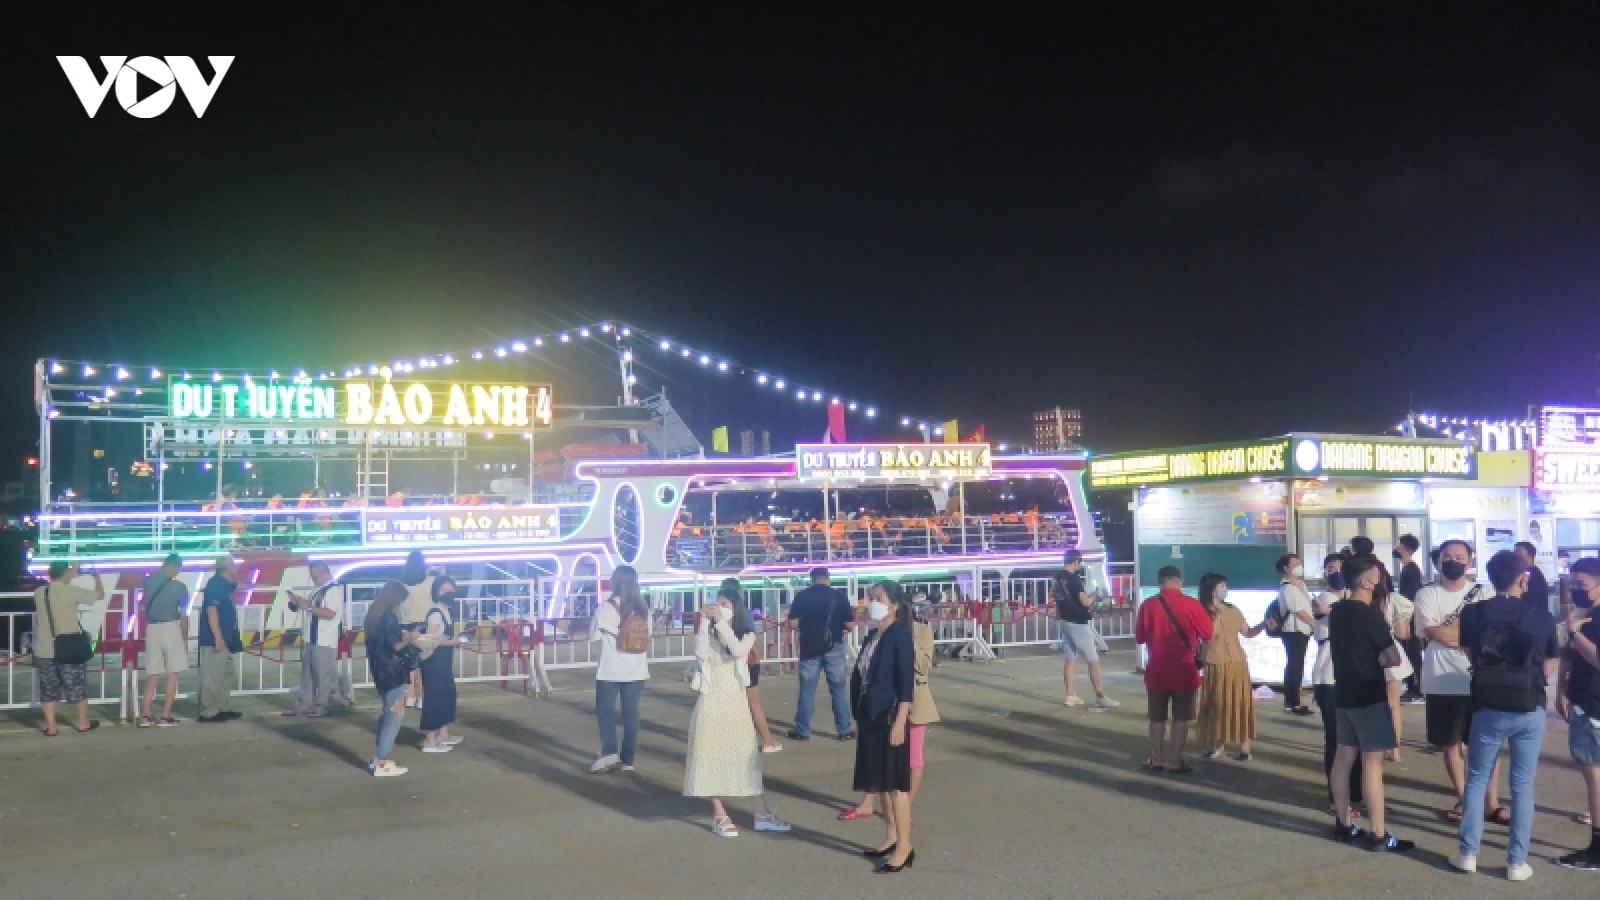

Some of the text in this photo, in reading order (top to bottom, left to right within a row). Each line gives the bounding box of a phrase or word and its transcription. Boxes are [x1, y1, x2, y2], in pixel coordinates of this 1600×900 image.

[173, 383, 213, 419] DU
[345, 366, 433, 425] BẢO
[443, 383, 529, 426] ANH
[535, 387, 551, 425] 4
[880, 445, 924, 467] BẢO
[928, 450, 973, 467] ANH
[1321, 441, 1373, 469] DANANG
[1375, 444, 1425, 472] DRAGON
[497, 515, 541, 528] ANH
